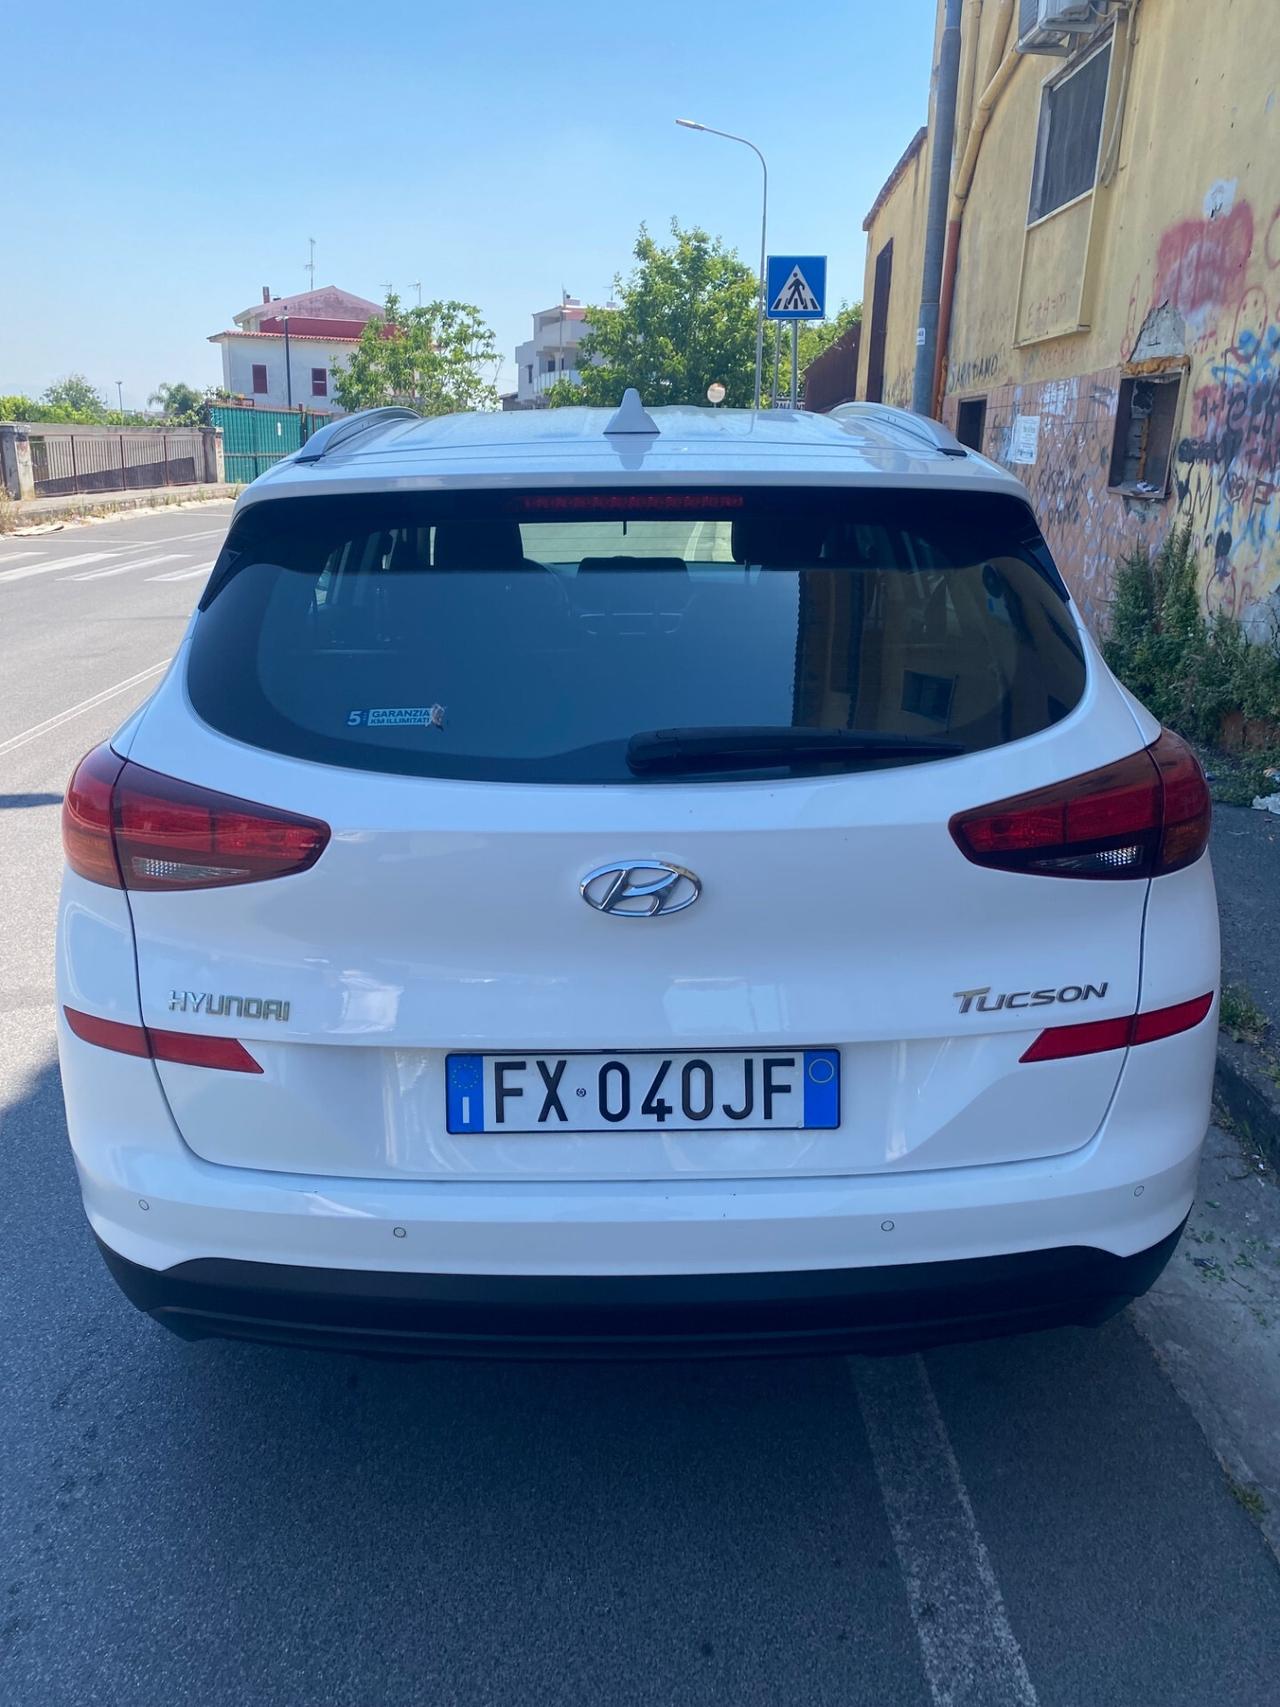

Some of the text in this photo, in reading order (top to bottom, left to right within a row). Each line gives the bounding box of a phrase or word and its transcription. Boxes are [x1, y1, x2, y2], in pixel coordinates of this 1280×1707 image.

[347, 711, 362, 726] 5
[372, 709, 430, 718] GARANZIA
[168, 990, 290, 1021] HYUNDAI
[953, 982, 1109, 1013] TUCSON
